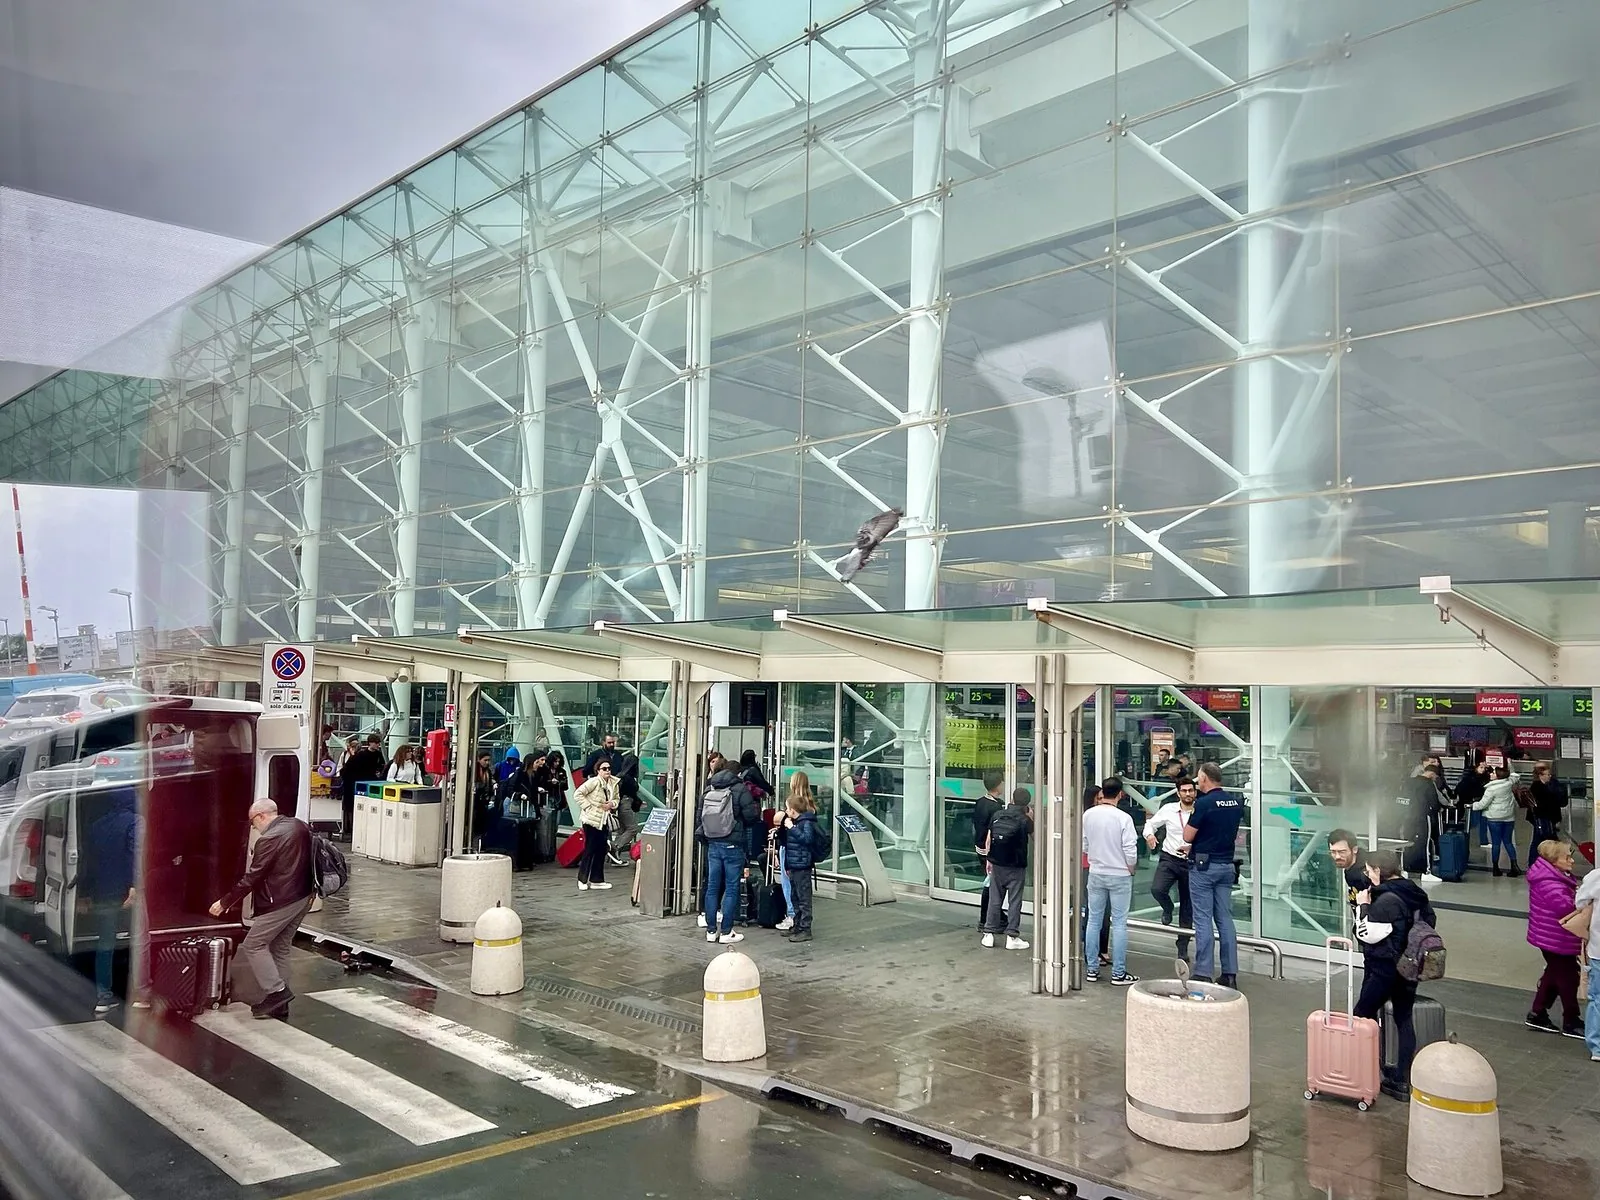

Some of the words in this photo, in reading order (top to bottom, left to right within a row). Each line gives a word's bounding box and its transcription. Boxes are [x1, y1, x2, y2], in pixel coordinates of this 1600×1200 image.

[865, 690, 875, 699] 22
[945, 692, 956, 701] 24
[971, 692, 982, 701] 25
[1130, 694, 1142, 704] 28
[1164, 695, 1176, 706] 29
[1416, 698, 1434, 710] 33
[1522, 699, 1542, 712] 34
[1575, 700, 1592, 712] 35
[978, 743, 1006, 752] SecureBa
